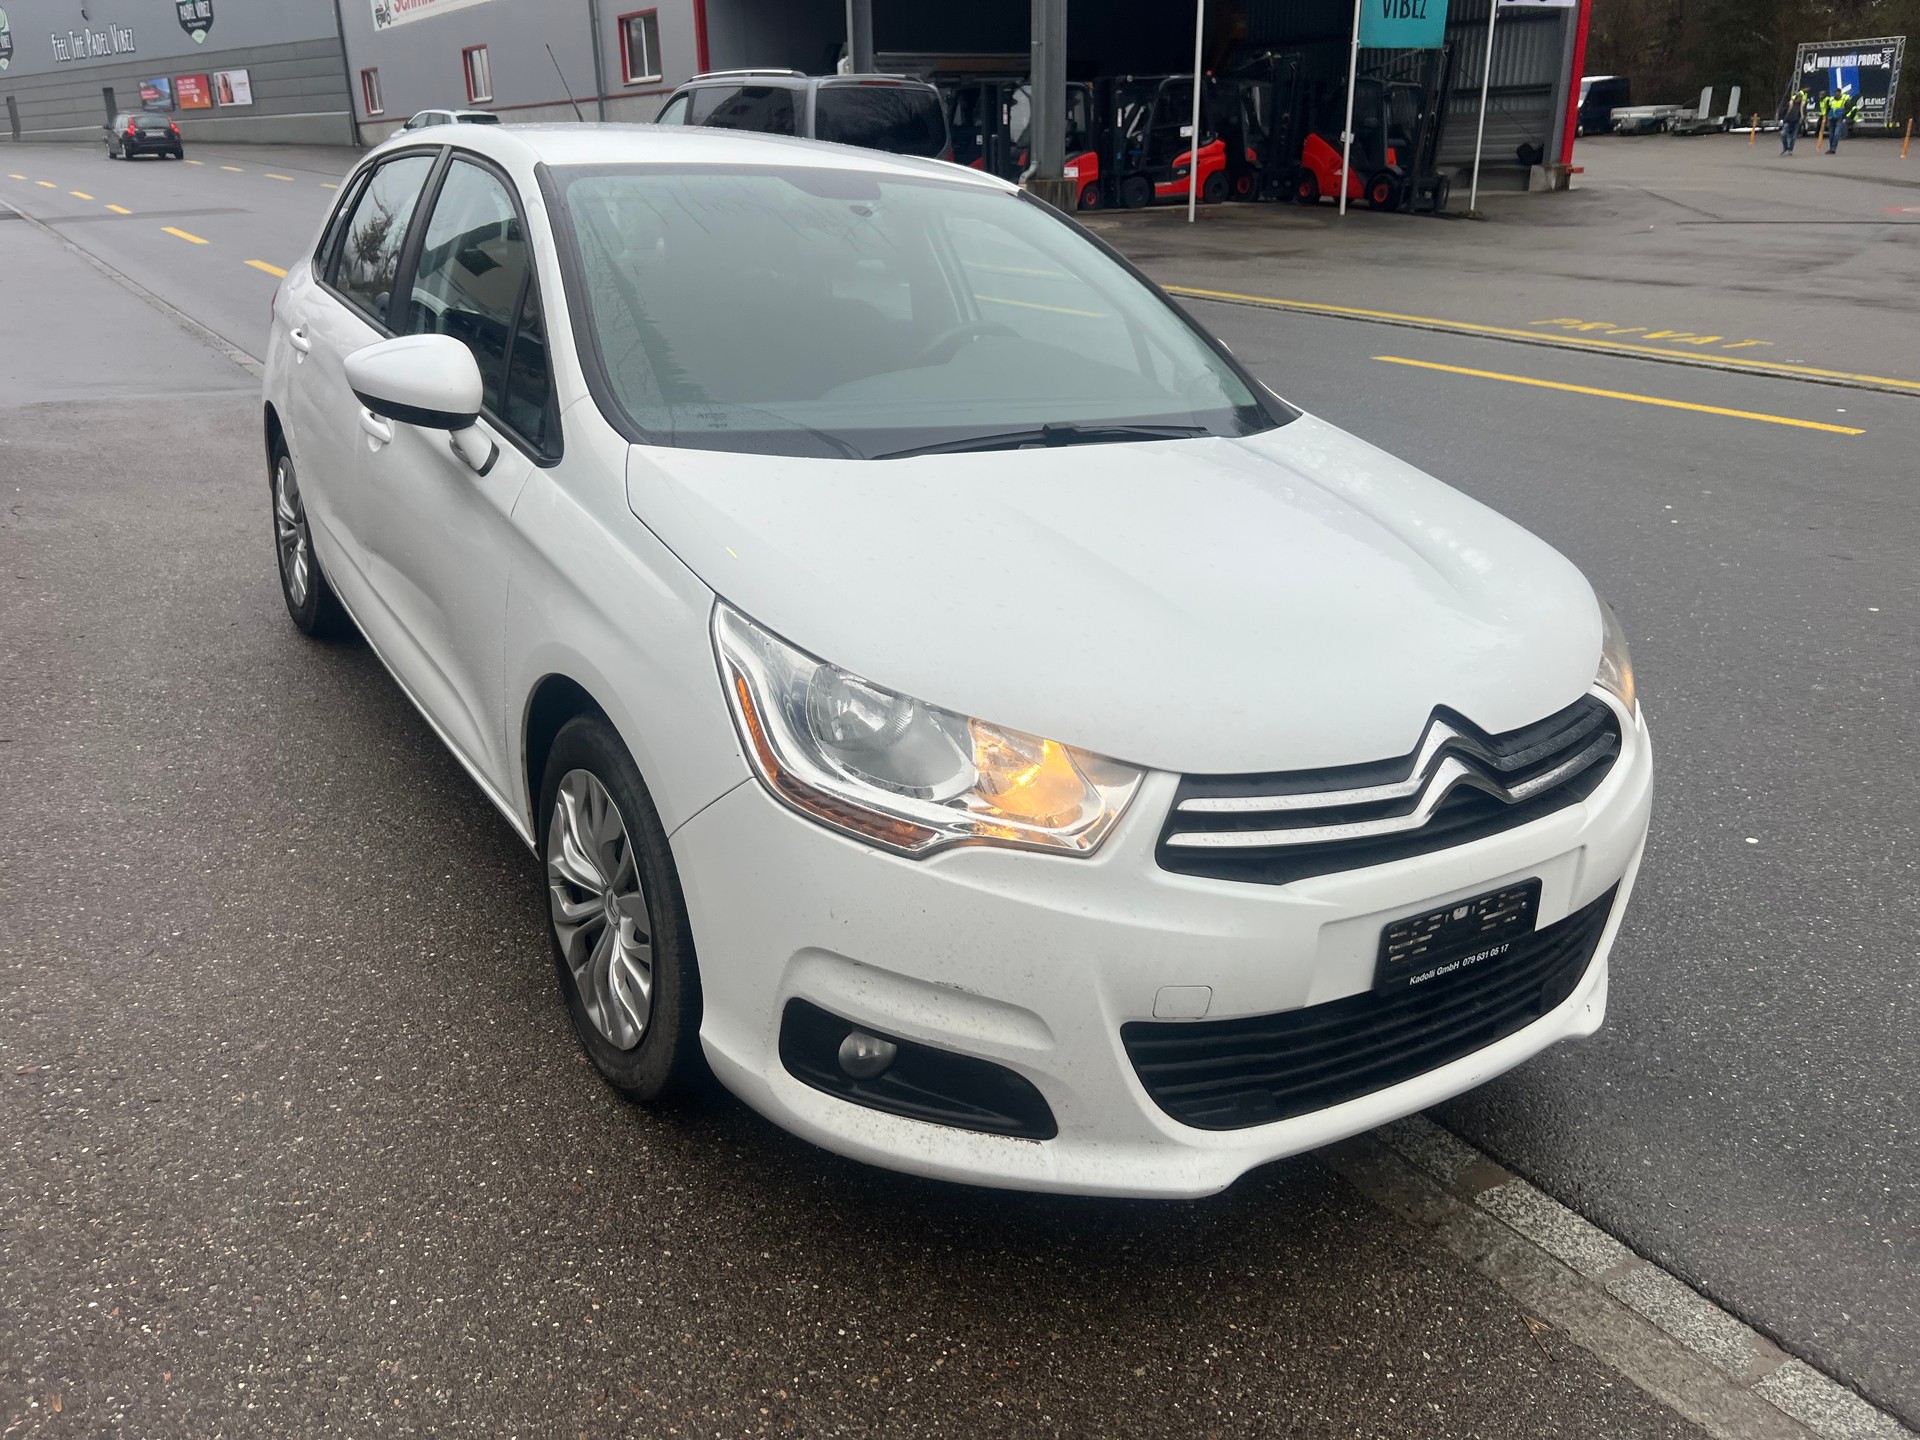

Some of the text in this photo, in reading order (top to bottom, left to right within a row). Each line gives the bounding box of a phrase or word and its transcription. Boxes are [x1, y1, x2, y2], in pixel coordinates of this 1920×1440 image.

[1830, 55, 1857, 68] MACHEN
[1528, 317, 1775, 349] PRIVAT
[1436, 960, 1460, 976] GmbH
[1462, 955, 1476, 967] 079
[1500, 943, 1510, 954] 17
